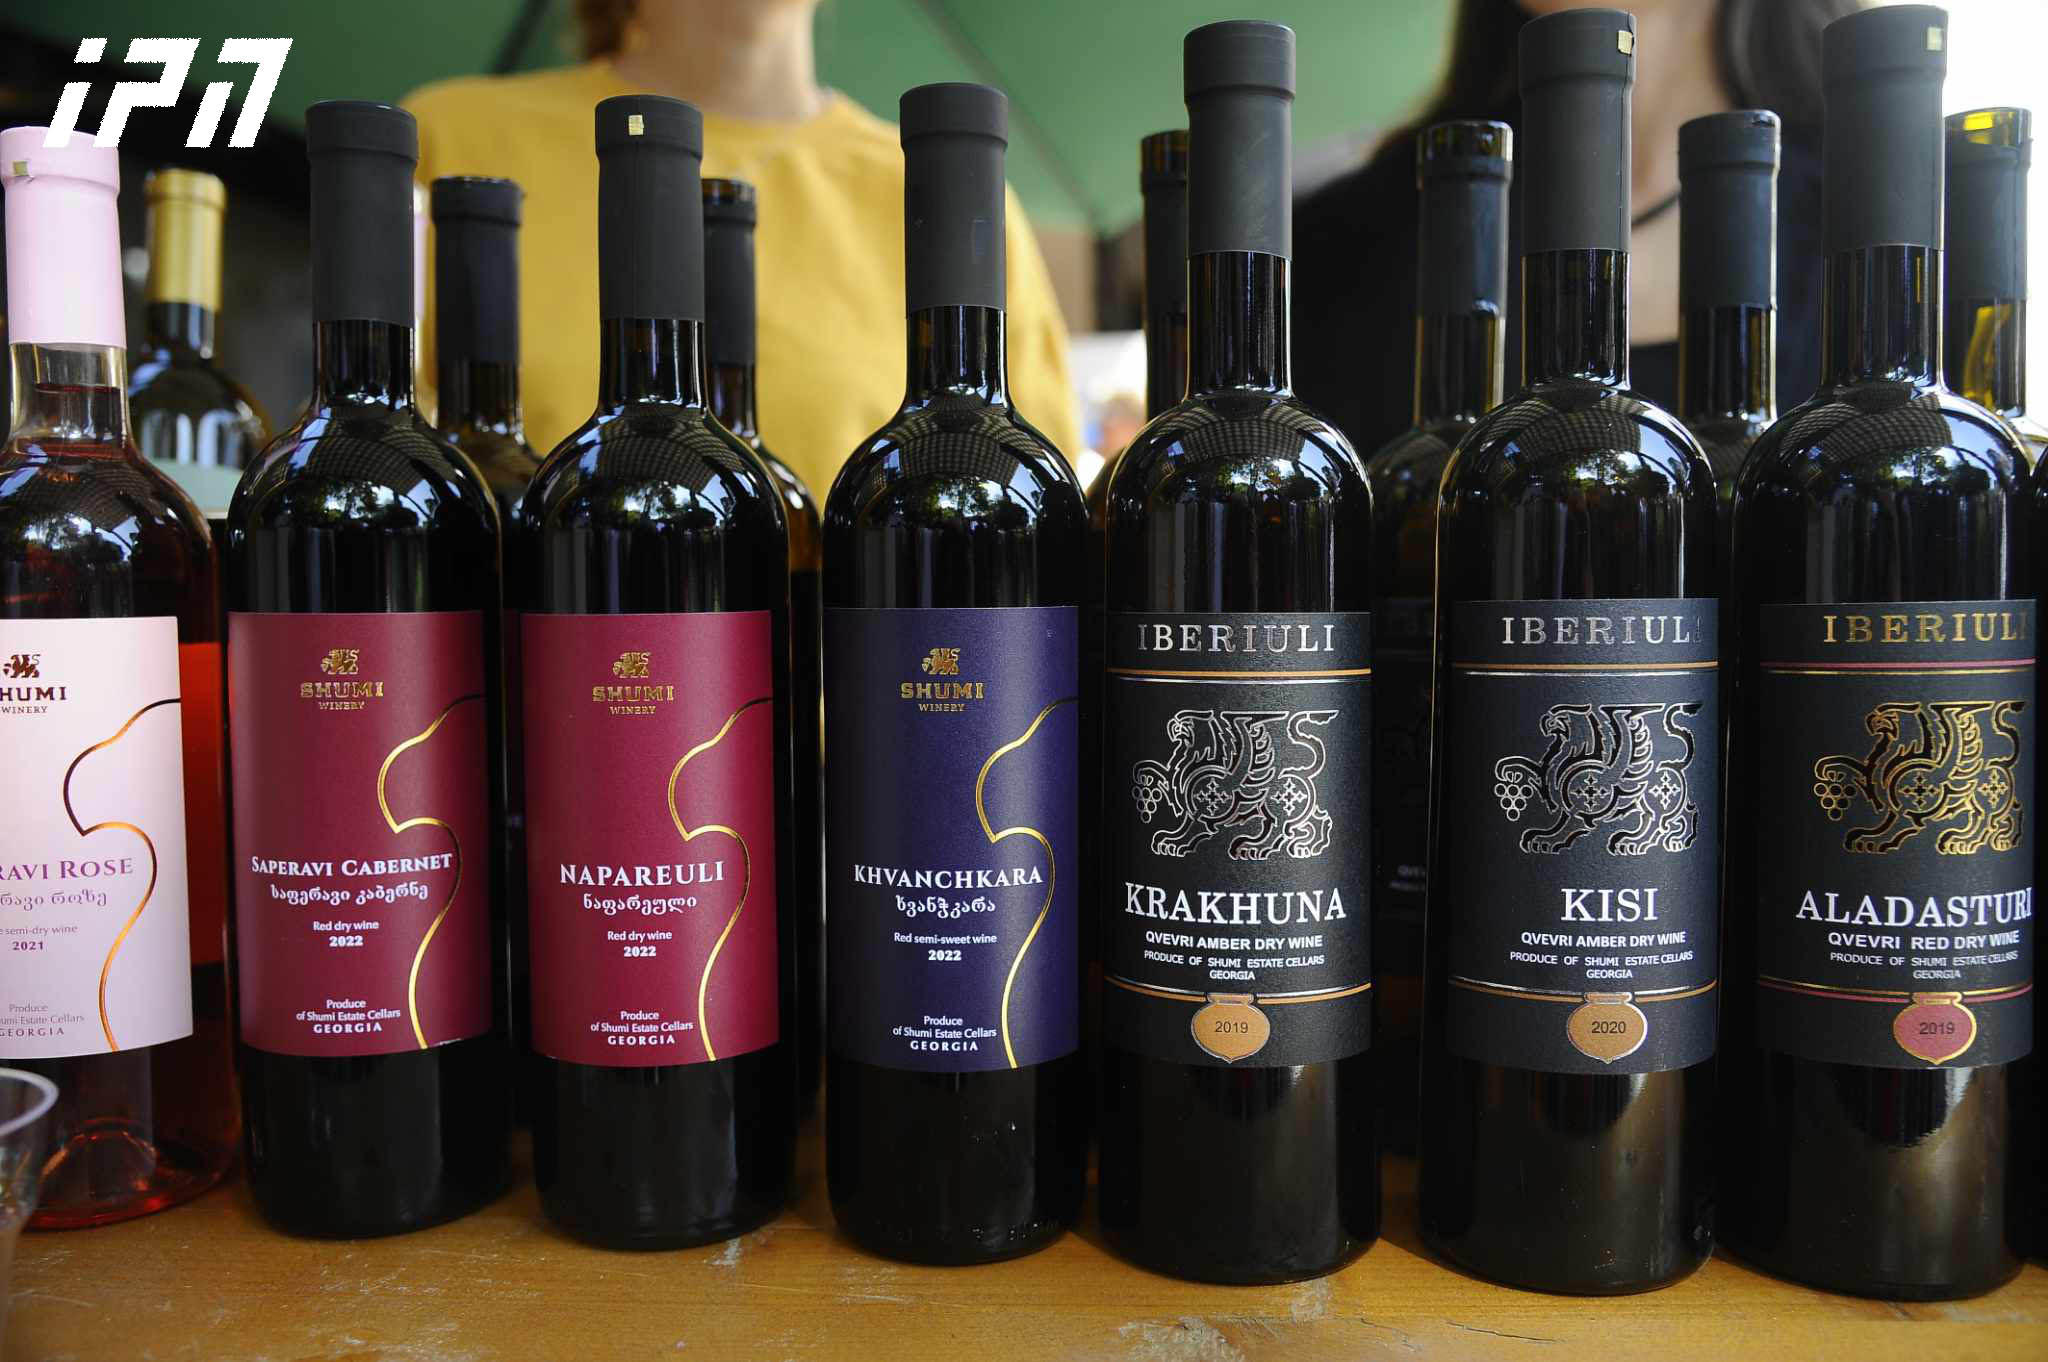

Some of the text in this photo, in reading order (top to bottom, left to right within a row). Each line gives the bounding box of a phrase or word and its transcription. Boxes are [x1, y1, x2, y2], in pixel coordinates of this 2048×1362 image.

[1823, 612, 2027, 643] IBERIULI
[1137, 623, 1335, 653] IBERIULI
[0, 686, 67, 701] HUMI
[300, 681, 385, 698] SHUMI
[592, 685, 675, 702] SHUMI
[901, 682, 985, 700] SHUMI
[1, 705, 48, 714] WINERY
[318, 702, 366, 711] WINERY
[610, 705, 656, 715] WINERY
[919, 703, 965, 713] WINERY
[60, 858, 133, 879] ROSE
[251, 853, 454, 877] SAPERAVI CABERNET
[559, 860, 725, 887] NAPAREULI
[854, 864, 1044, 889] KHVANCHKARA
[270, 882, 429, 906] საფერავი კაბერნე
[0, 892, 44, 912] რავი
[583, 893, 697, 916] ნაფარეული
[895, 894, 996, 919] ხვანჭკარა
[1125, 881, 1347, 926] KRAKHUNA
[1560, 887, 1660, 923] KISI
[1796, 887, 2033, 928] ALADASTURI
[6, 926, 48, 937] semi-dry
[52, 925, 78, 934] wine
[313, 920, 380, 933] Red dry wine
[329, 935, 364, 947] 2022
[607, 929, 673, 943] Red dry wine
[893, 931, 997, 945] Red semi-sweet wine
[1145, 930, 1323, 951] QVEVRI AMBER DRY WINE
[1521, 930, 1687, 949] QVEVRI AMBER DRY WINE
[1828, 930, 2020, 951] QVEVRI RED DRY WINE
[12, 941, 44, 951] 2021
[623, 946, 657, 957] 2022
[928, 949, 962, 962] 2022
[1144, 949, 1325, 969] PRODUCE OF SHUMI ESTATE CELLARS
[1510, 950, 1694, 968] PRODUCE OF SHUMI ESTATE CELLARS
[1830, 951, 1883, 966] PRODUCE
[1889, 955, 1905, 966] OF
[1911, 956, 1948, 968] SHUMI
[1953, 954, 1988, 967] ESTATE
[1209, 969, 1255, 981] GEORGIA
[1586, 968, 1634, 979] GEORGIA
[1913, 968, 1962, 980] GEORGIA
[9, 1003, 48, 1013] Produce
[326, 998, 367, 1009] Produce
[296, 1008, 401, 1022] of Shumi Estate Cellars
[620, 1010, 659, 1020] Produce
[924, 1015, 963, 1026] Produce
[313, 1022, 383, 1034] GEORGIA
[590, 1020, 693, 1033] of Shumi Estate Cellars
[892, 1026, 997, 1039] of Shumi Estate Cellars
[1214, 1020, 1249, 1034] 2019
[1591, 1021, 1627, 1035] 2020
[1919, 1021, 1956, 1036] 2019
[607, 1035, 676, 1047] GEORGIA
[910, 1040, 979, 1052] GEORGIA
